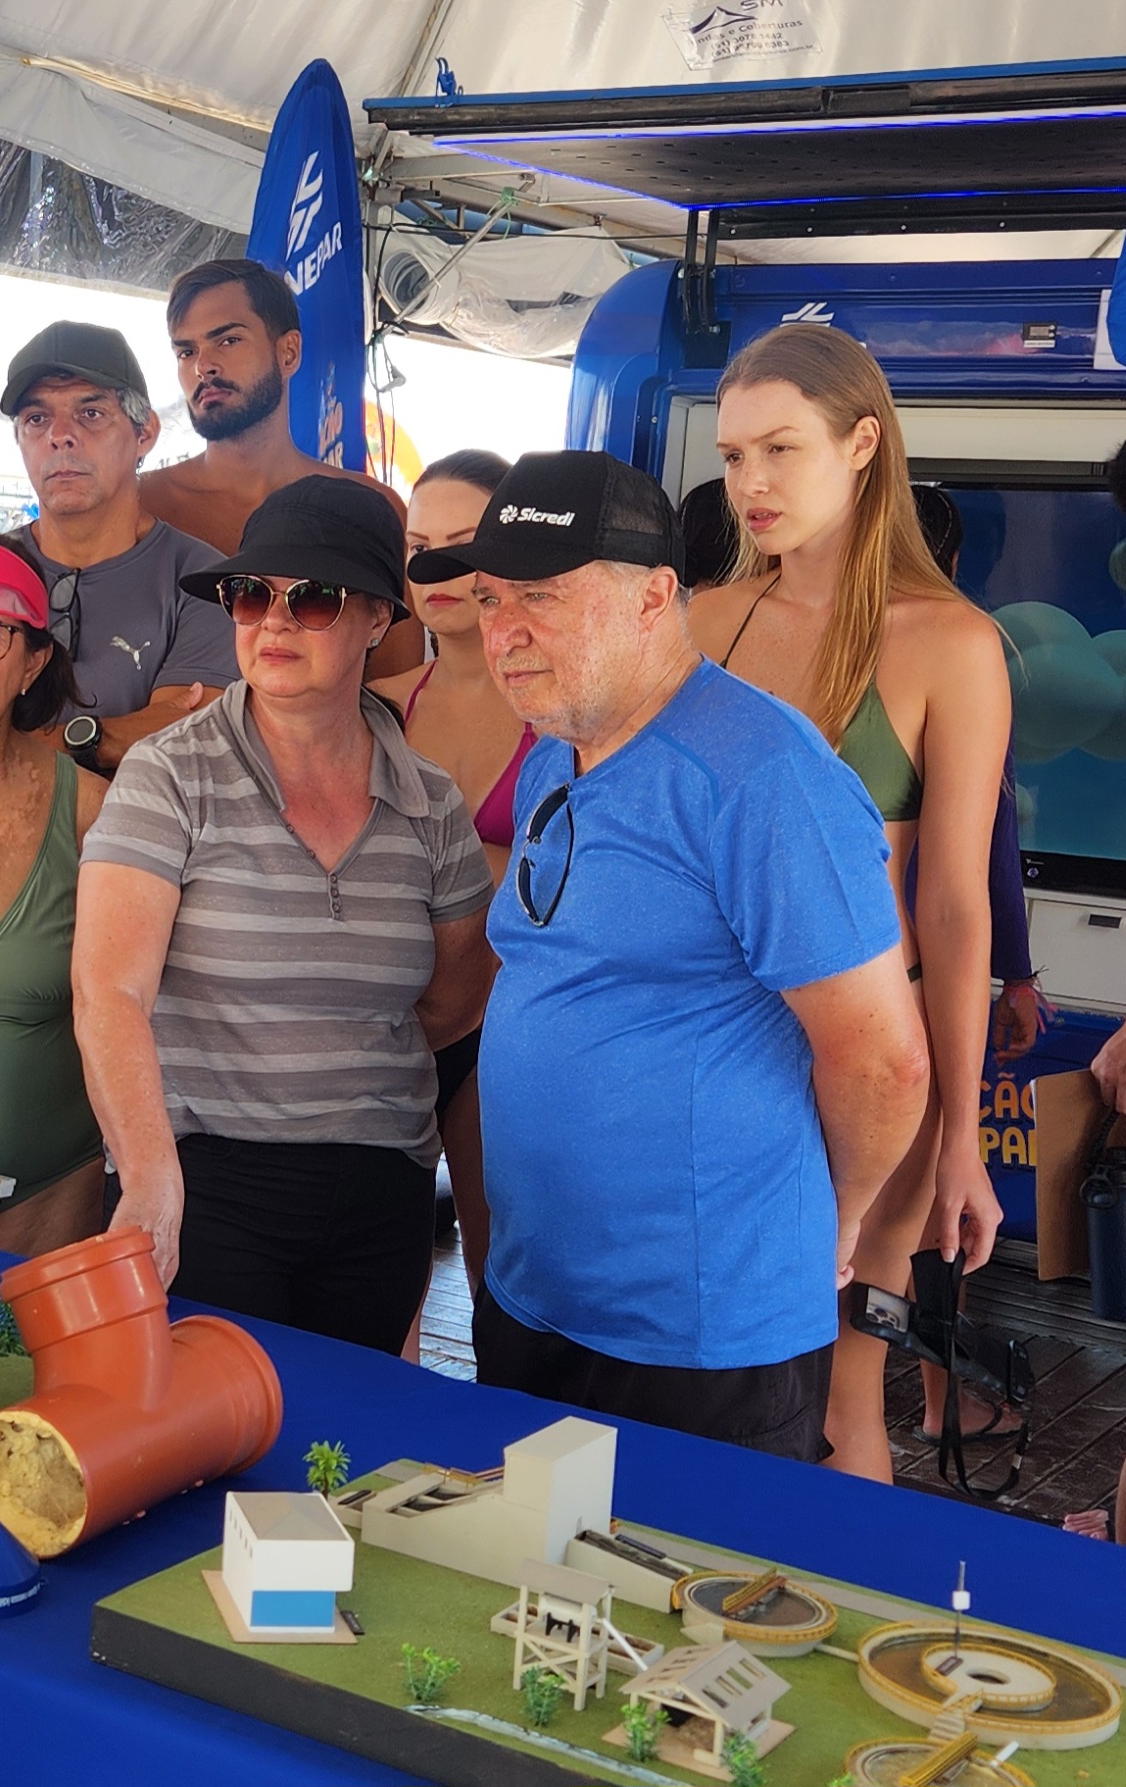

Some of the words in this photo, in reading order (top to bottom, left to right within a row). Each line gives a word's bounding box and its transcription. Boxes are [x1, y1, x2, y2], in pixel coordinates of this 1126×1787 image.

[738, 20, 803, 33] Coberturas
[283, 221, 342, 297] NEPAR
[517, 507, 576, 527] Sicredi
